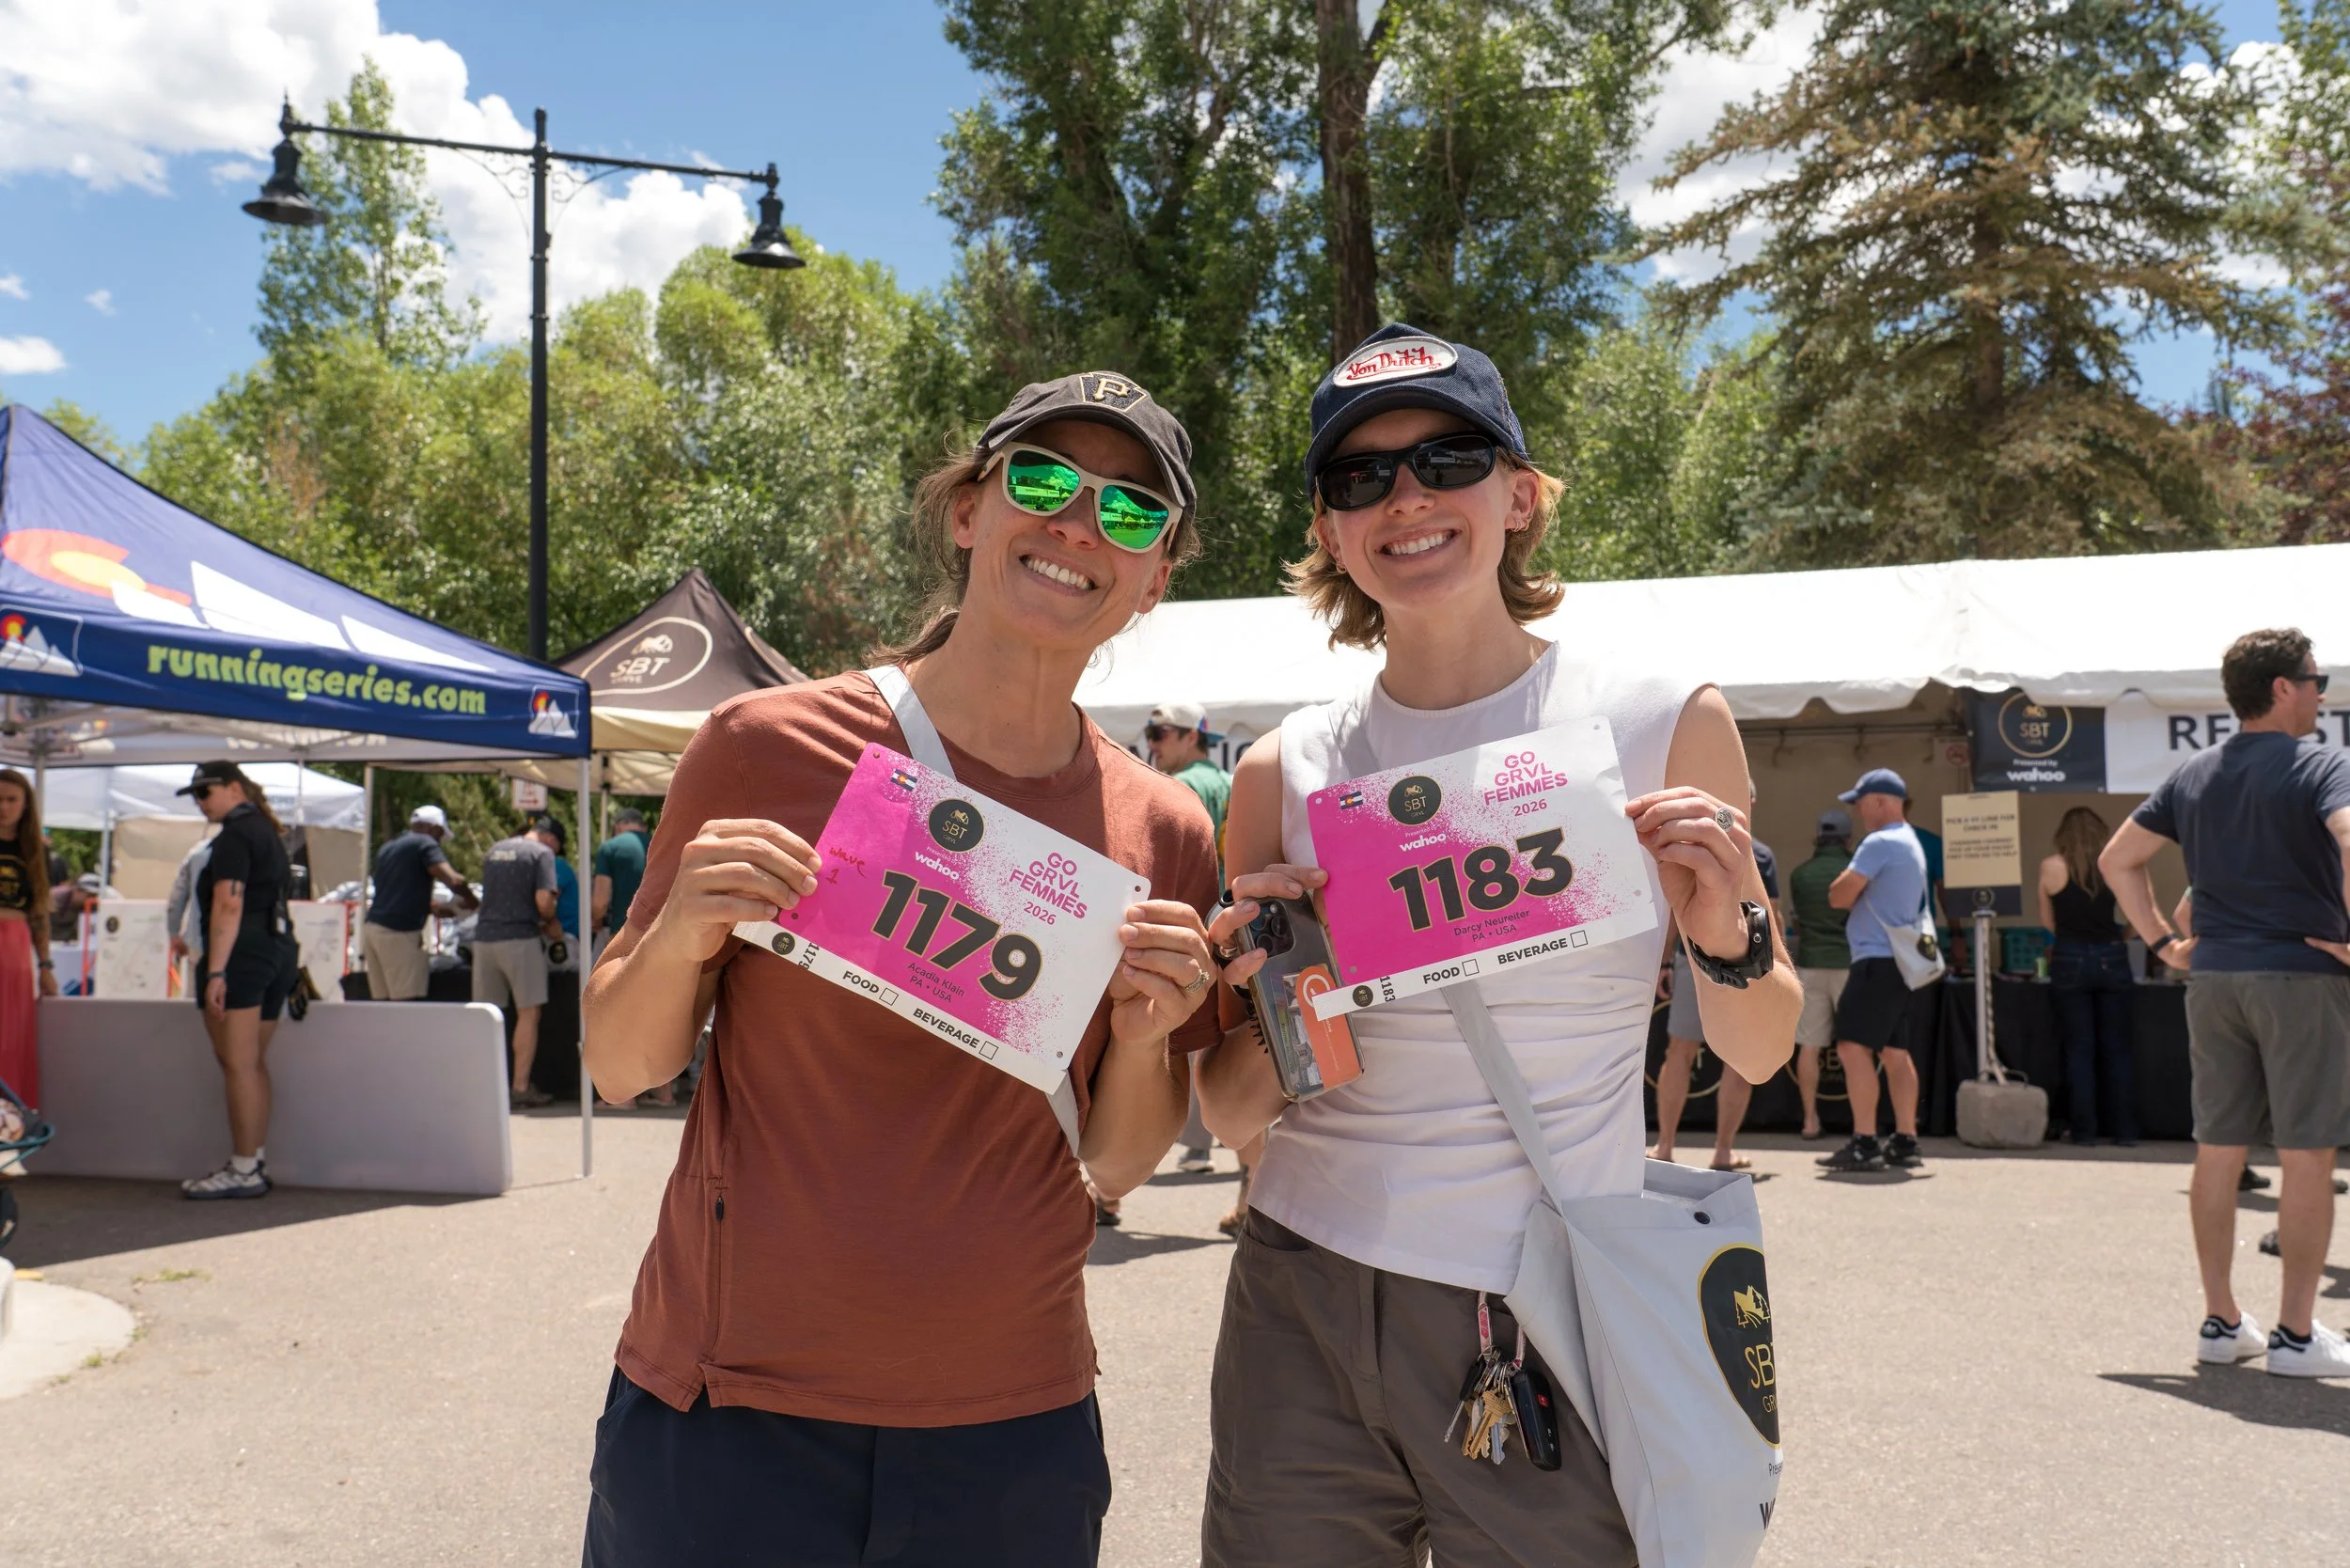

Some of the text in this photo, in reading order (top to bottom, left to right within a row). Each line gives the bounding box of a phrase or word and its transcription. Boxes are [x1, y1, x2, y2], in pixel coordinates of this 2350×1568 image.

[1347, 346, 1434, 377] Von Dutch
[1092, 377, 1130, 401] P
[147, 644, 487, 715] runningseries.com
[609, 657, 670, 678] SBT
[2019, 721, 2050, 739] SBT
[1504, 750, 1536, 769] GO
[1494, 761, 1553, 787] GRVL
[2006, 766, 2066, 782] wahoo
[1483, 772, 1569, 807] FEMMES
[1403, 795, 1427, 812] SBT
[1512, 798, 1548, 817] 2026
[942, 820, 968, 839] SBT
[1399, 833, 1447, 852] wahoo
[915, 851, 960, 881] wahoo
[1047, 852, 1078, 876] GO
[1028, 860, 1080, 900] GRVL
[1386, 825, 1575, 933] 1183
[1009, 868, 1088, 919] FEMMES
[1023, 901, 1057, 926] 2026
[1453, 910, 1530, 936] Darcy Neureiter
[870, 869, 1043, 1002] 1179
[1471, 924, 1517, 942] PA USA
[1496, 938, 1569, 965] BEVERAGE
[842, 970, 880, 995] FOOD
[907, 962, 965, 997] Acadia Klain
[1422, 966, 1461, 984] FOOD
[909, 975, 952, 1003] PA USA
[1379, 975, 1396, 1003] 1183
[913, 1007, 980, 1050] BEVERAGE
[1744, 1341, 1777, 1390] SB
